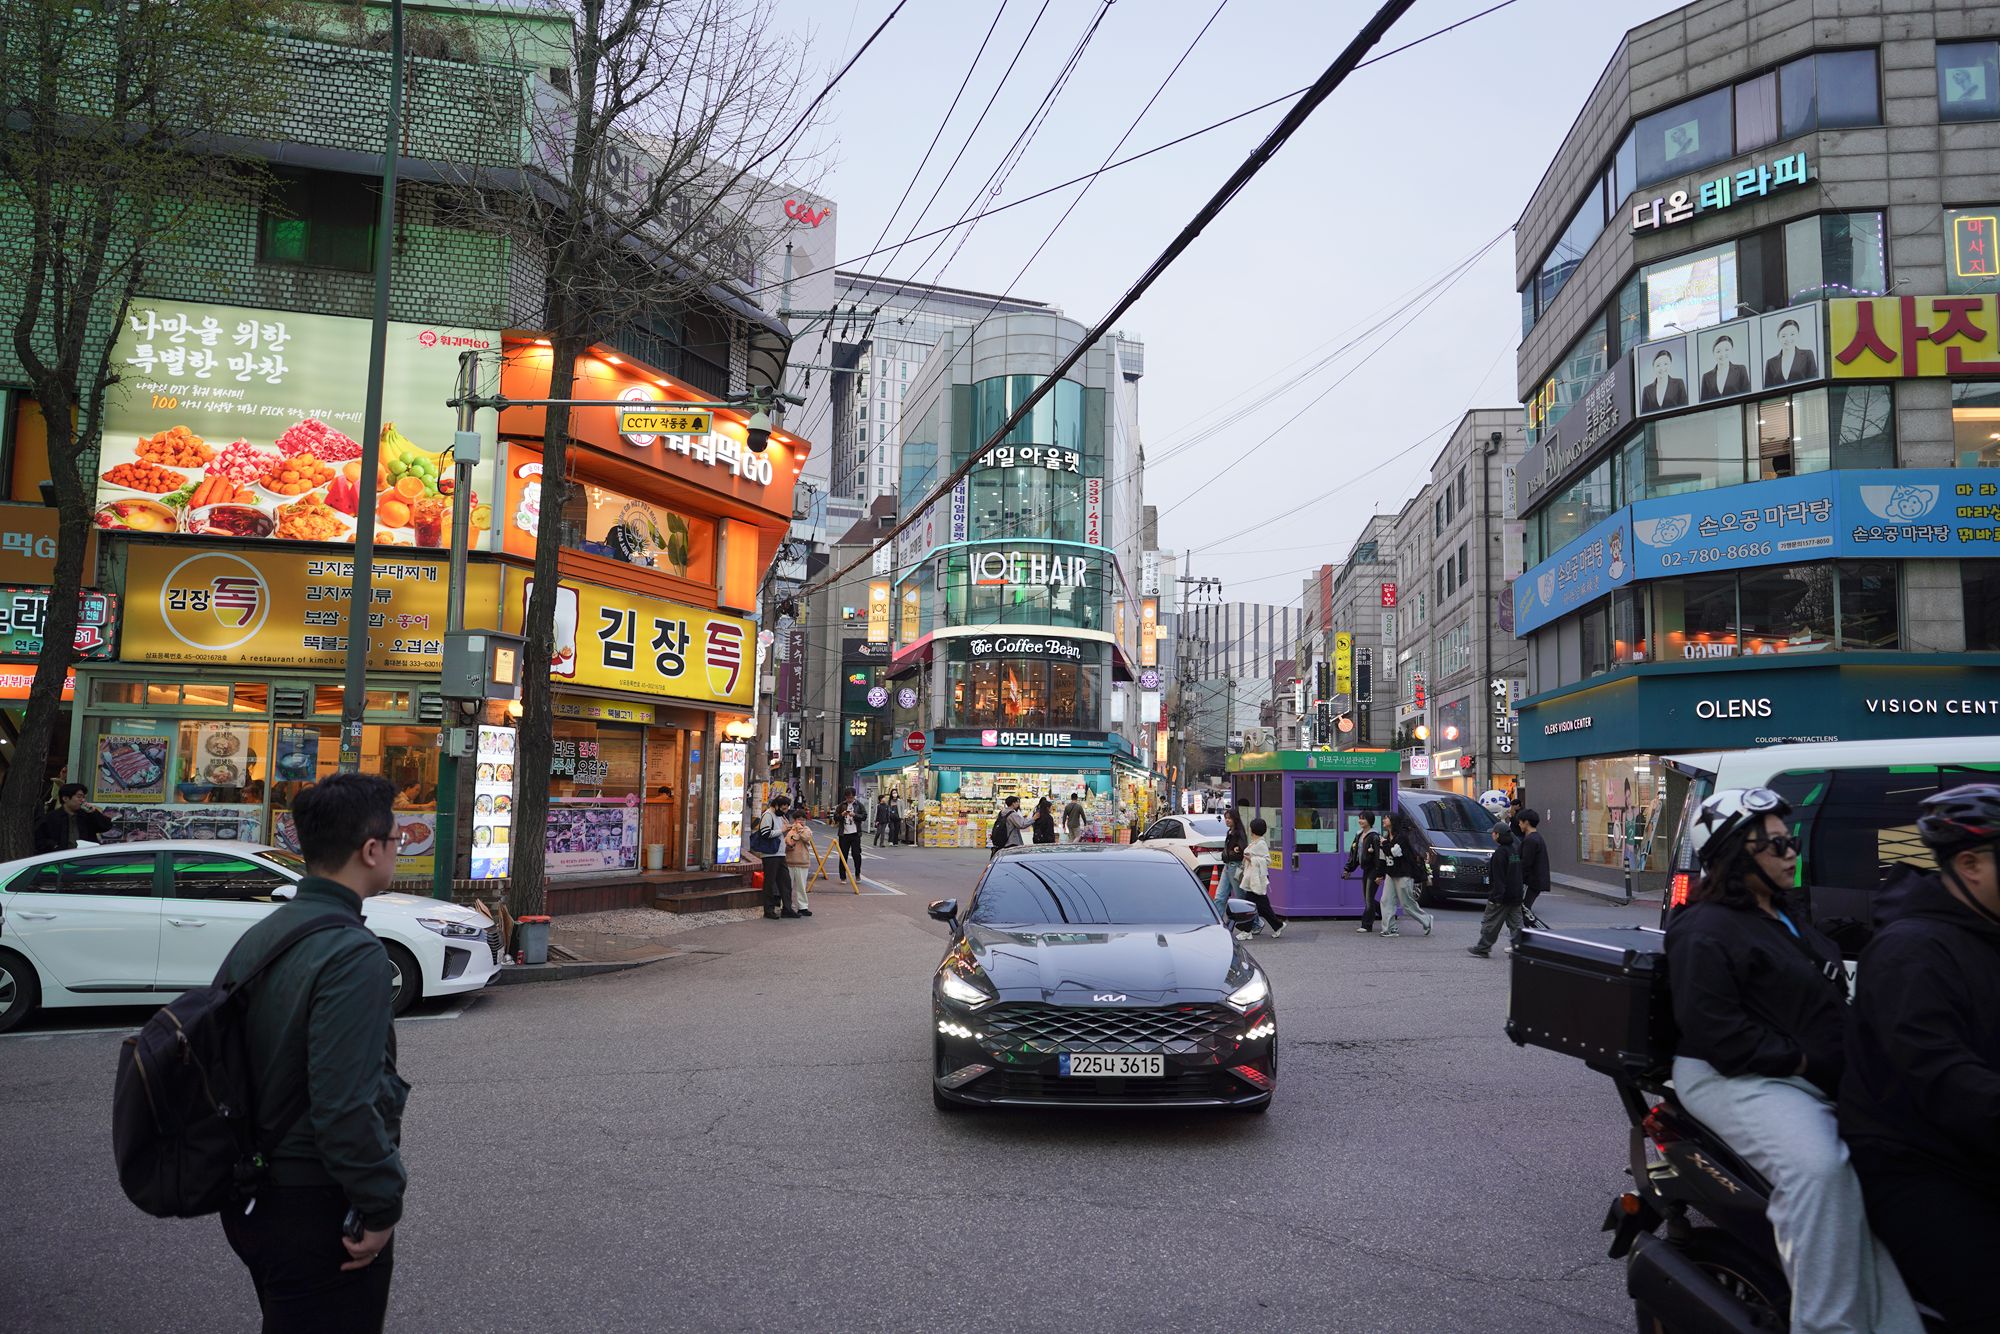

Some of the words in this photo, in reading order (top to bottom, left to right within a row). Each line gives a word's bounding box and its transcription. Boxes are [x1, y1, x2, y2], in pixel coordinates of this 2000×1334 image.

[1967, 219, 1986, 274] 마사지
[129, 310, 224, 346] 나만을
[232, 320, 292, 352] 위한
[126, 343, 219, 379] 특별한
[227, 351, 290, 384] 만찬
[169, 384, 190, 396] DIY
[151, 394, 178, 410] 100
[180, 399, 202, 411] 가지
[203, 400, 235, 414] 신선한
[259, 405, 285, 418] PICK
[627, 417, 658, 429] CCTV
[659, 417, 689, 430] 작동중
[978, 446, 1015, 468] 네일
[1019, 446, 1080, 475] 아울렛
[1088, 479, 1100, 545] 333-4145
[1698, 508, 1761, 538] 손오공
[1764, 498, 1833, 529] 마라탕
[1853, 525, 1900, 543] 손오공
[1901, 525, 1950, 543] 마라탕
[1558, 551, 1580, 590] 손오공
[1580, 536, 1604, 576] 마라탕
[1661, 541, 1773, 568] 02-780-8686
[370, 563, 439, 582] 부대찌개
[969, 551, 1023, 585] VOG
[1031, 553, 1087, 588] HAIR
[872, 603, 888, 615] VOG
[303, 611, 341, 627] 보쌈
[397, 614, 431, 630] 홍어
[303, 635, 371, 652] 뚝불고
[970, 638, 993, 656] The
[994, 638, 1043, 653] Coffee
[1044, 639, 1081, 660] Bean
[249, 655, 295, 663] restaurant
[309, 656, 337, 664] kimchi
[1696, 698, 1773, 719] OLENS
[1866, 699, 1938, 713] VISION
[1945, 700, 1999, 714] CENT
[1544, 724, 1558, 736] OLENS
[1558, 720, 1574, 733] VISION
[1573, 716, 1592, 730] CENTER
[1000, 731, 1072, 748] 하모니마트
[553, 740, 576, 758] 라도
[578, 741, 600, 760] 김치
[577, 761, 609, 777] 오겹살
[1093, 994, 1127, 1002] KIA
[1119, 1057, 1161, 1074] 3615
